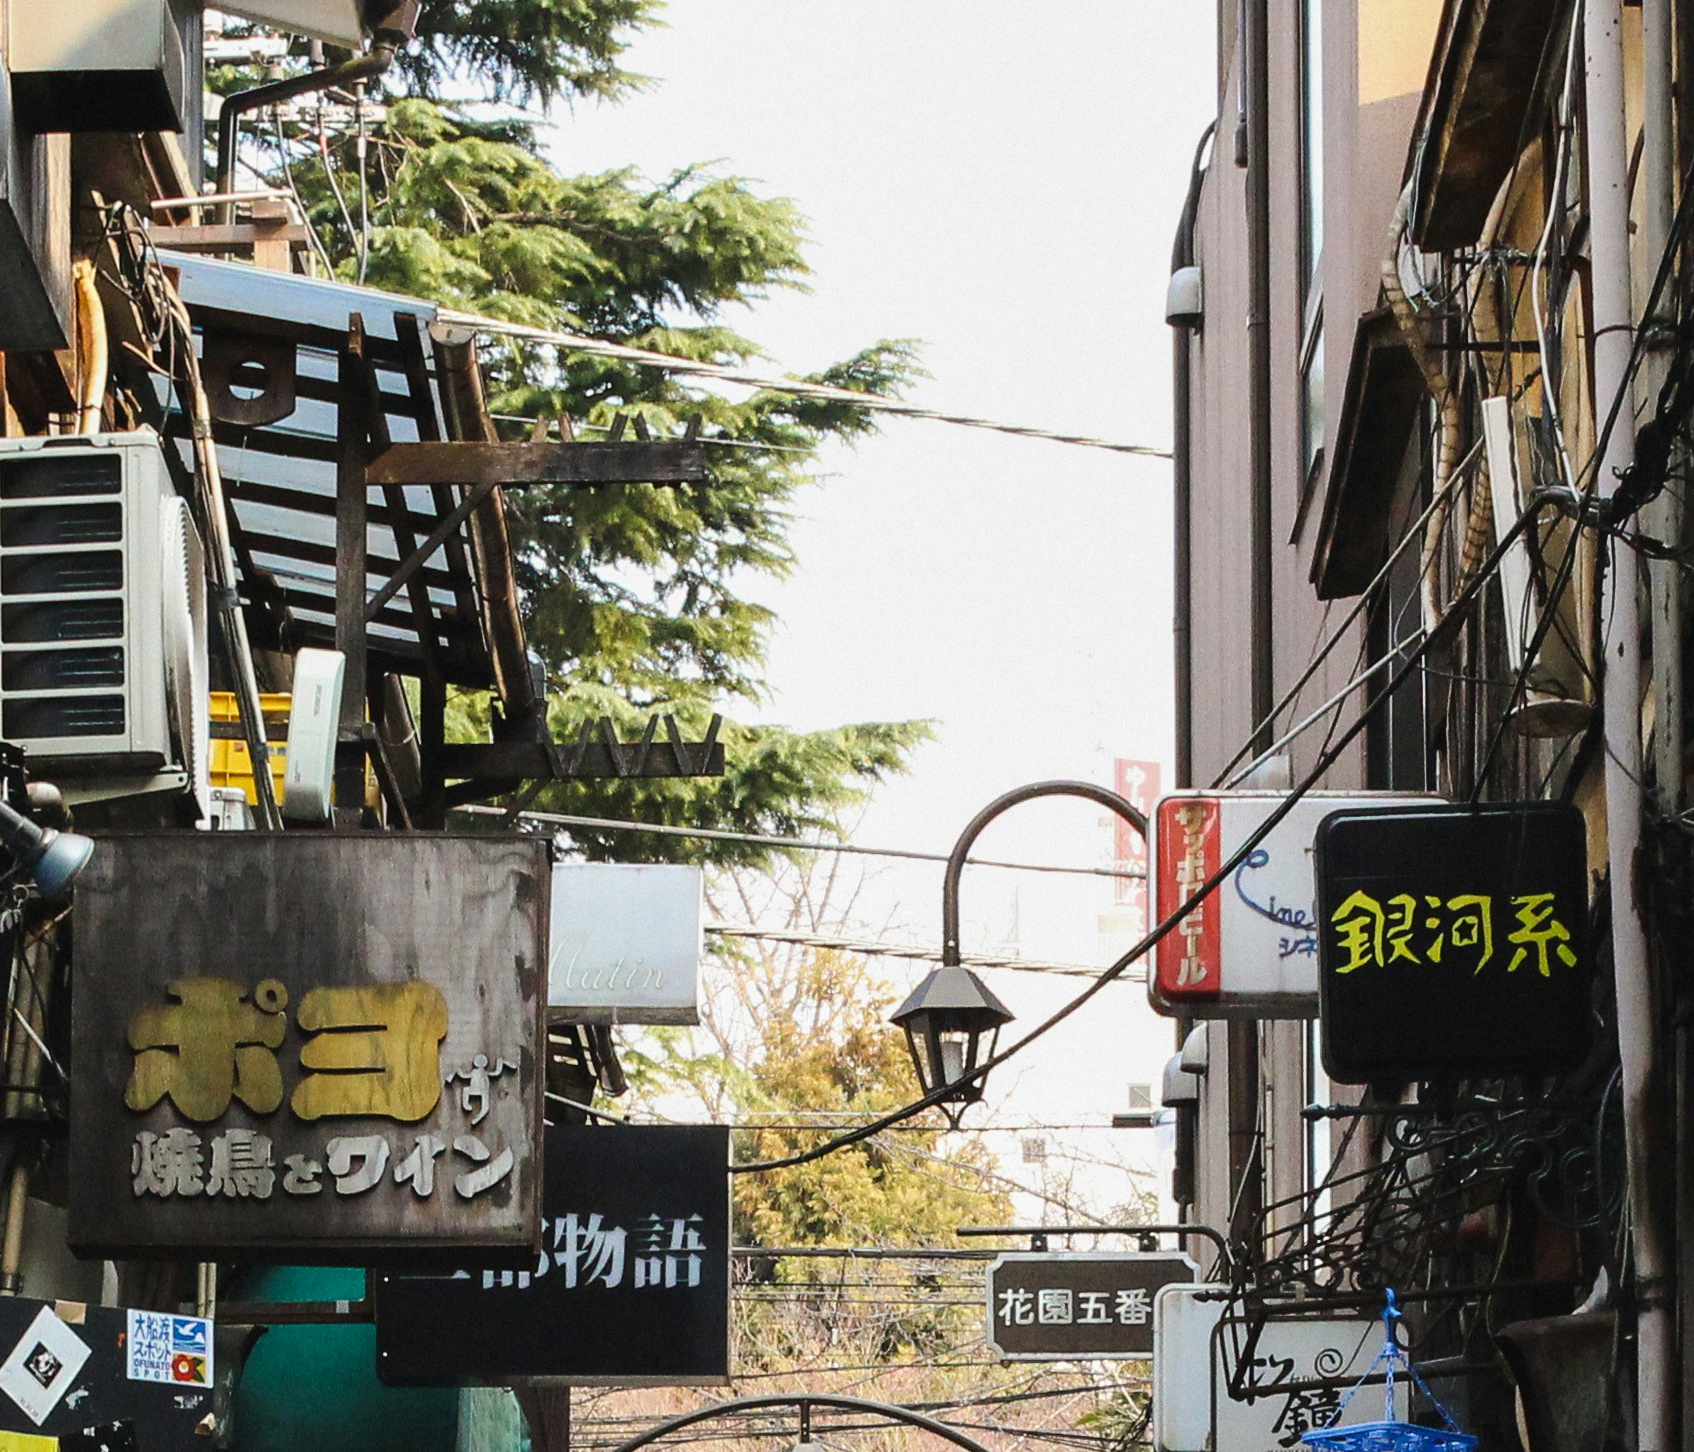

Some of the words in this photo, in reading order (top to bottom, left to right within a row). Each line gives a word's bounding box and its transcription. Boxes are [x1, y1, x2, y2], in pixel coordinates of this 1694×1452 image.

[1331, 890, 1576, 977] 銀河系
[124, 977, 448, 1121] ポヨ
[132, 1127, 514, 1198] 焼鳥とワイン
[399, 1213, 706, 1289] 物語
[134, 1313, 171, 1342] 大船渡
[998, 1288, 1152, 1326] 花園五番
[133, 1359, 171, 1371] OFUNATO
